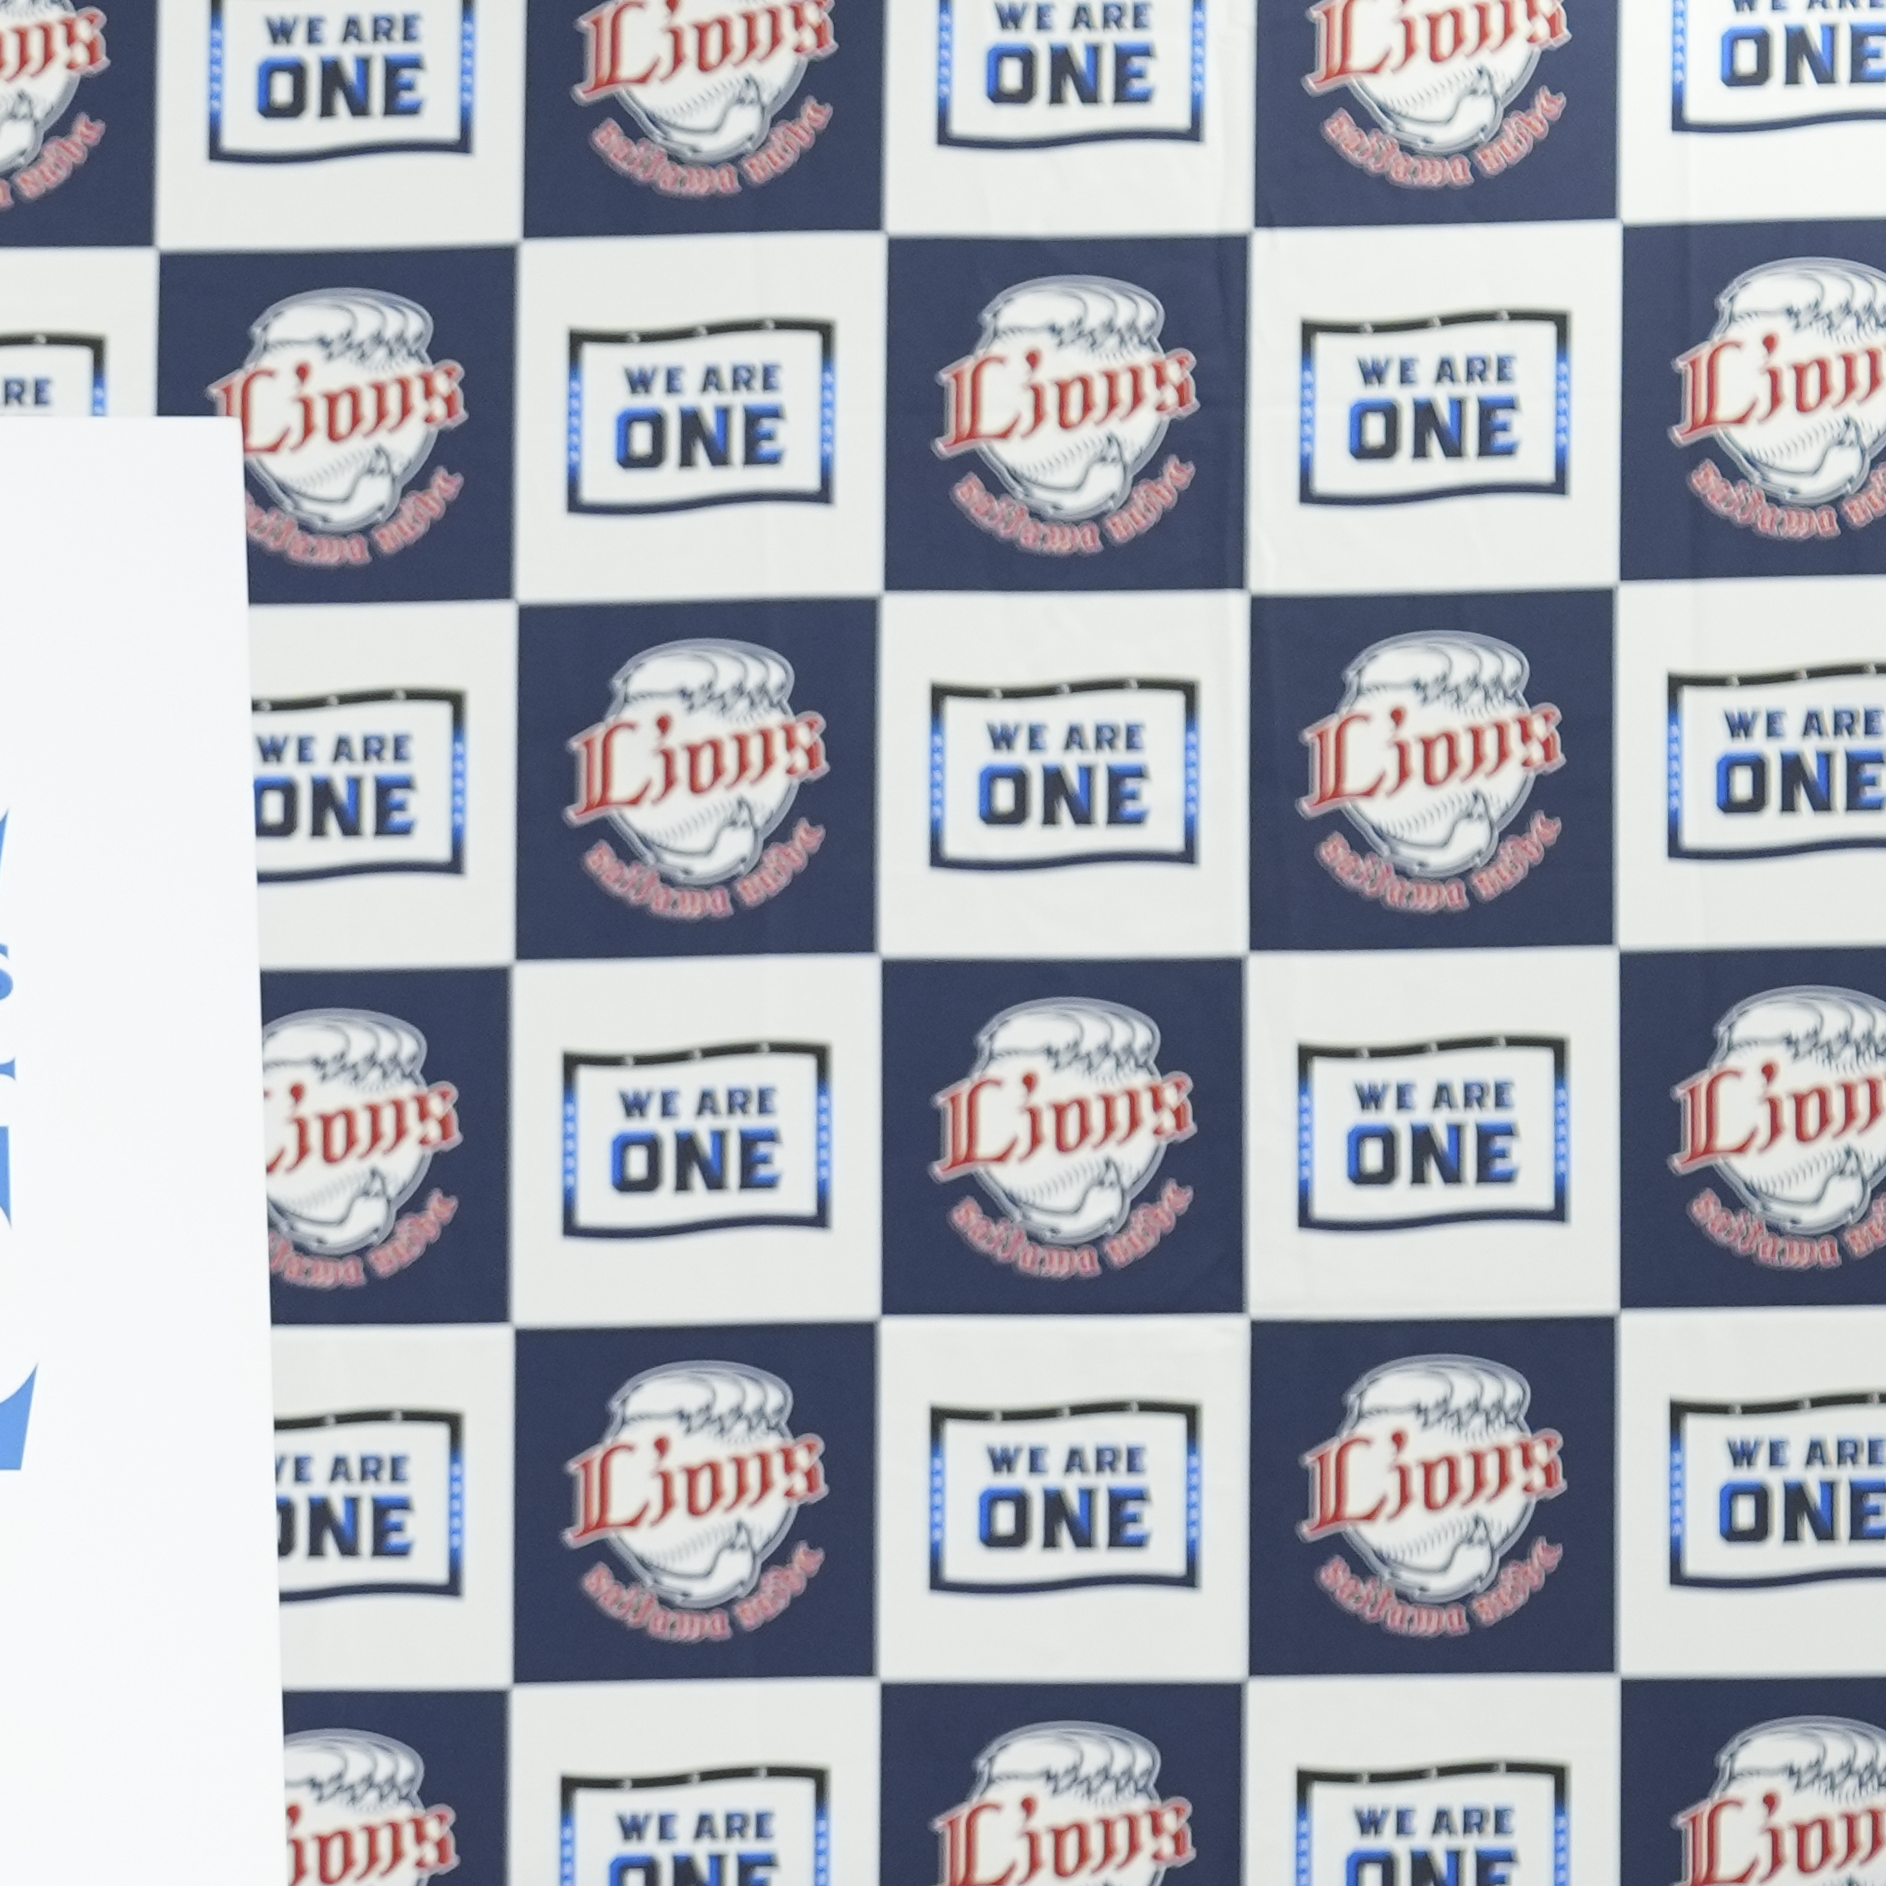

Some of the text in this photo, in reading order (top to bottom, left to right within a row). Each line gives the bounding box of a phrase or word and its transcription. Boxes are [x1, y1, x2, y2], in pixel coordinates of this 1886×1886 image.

[625, 364, 780, 395] WE ARE
[943, 350, 1195, 451] Lions
[1358, 355, 1514, 387] WE ARE
[615, 404, 784, 470] ONE
[1349, 396, 1518, 461] ONE
[574, 714, 825, 819] Lions
[987, 723, 1143, 752] WE ARE
[1308, 706, 1562, 810] Lions
[978, 764, 1148, 826] ONE
[619, 1087, 775, 1119] WE ARE
[938, 1071, 1192, 1174] Lions
[1355, 1081, 1512, 1112] WE ARE
[611, 1128, 780, 1194] ONE
[1347, 1122, 1517, 1186] ONE
[572, 1436, 823, 1541] Lions
[987, 1446, 1144, 1475] WE ARE
[1307, 1430, 1563, 1534] Lions
[978, 1487, 1150, 1550] ONE
[617, 1811, 773, 1842] WE ARE
[1354, 1807, 1513, 1837] WE ARE
